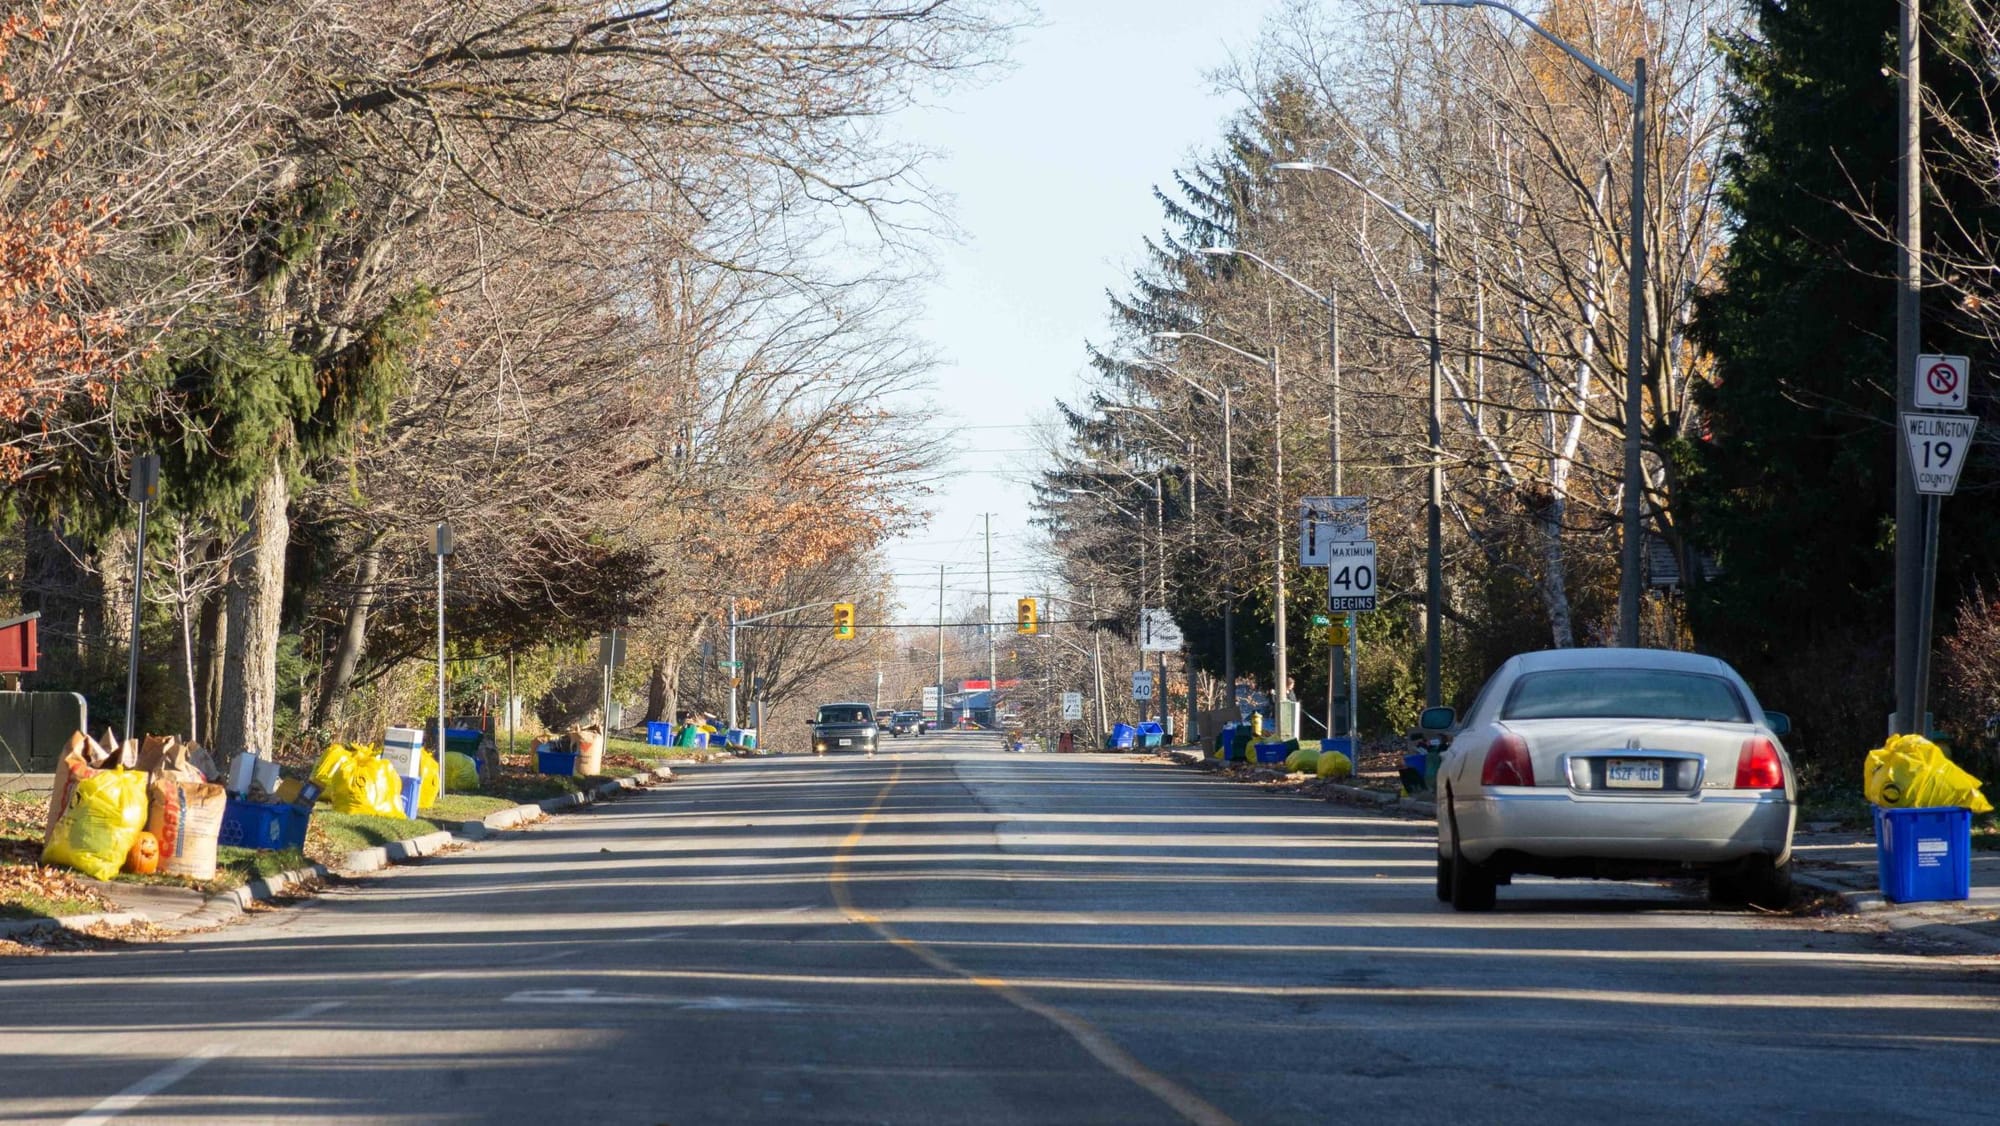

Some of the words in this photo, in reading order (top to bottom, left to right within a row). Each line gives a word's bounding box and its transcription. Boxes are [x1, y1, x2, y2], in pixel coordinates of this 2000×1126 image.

[1910, 419, 1969, 438] WELLINGTON
[1923, 441, 1952, 468] 19
[1920, 473, 1953, 485] COUNTY
[1332, 548, 1373, 557] MAXIMUM
[1333, 565, 1372, 590] 40
[1333, 598, 1373, 610] BEGINS
[1135, 684, 1150, 696] 40
